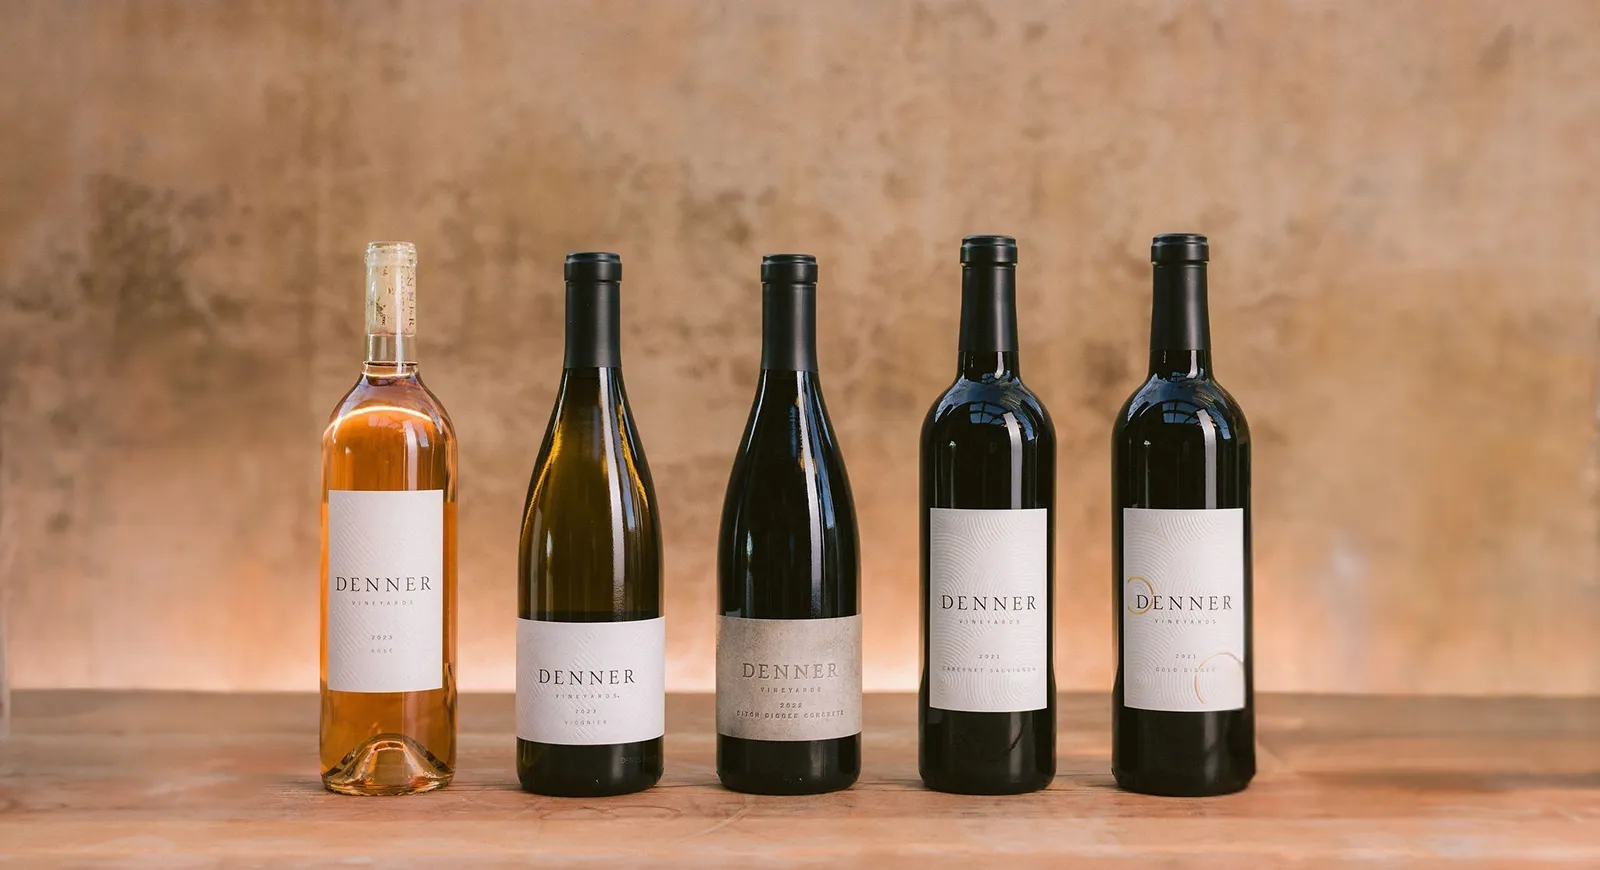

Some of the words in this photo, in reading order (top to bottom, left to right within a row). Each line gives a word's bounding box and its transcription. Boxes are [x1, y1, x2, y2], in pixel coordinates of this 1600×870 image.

[335, 576, 432, 592] DENNER
[940, 594, 1037, 611] DENNER
[1136, 594, 1233, 611] DENNER
[538, 668, 635, 686] DENNER
[742, 662, 839, 680] DENNER
[989, 666, 1037, 674] SAUVIGNON
[760, 686, 822, 694] VINEYARDS
[736, 710, 760, 718] DITCH
[803, 709, 845, 719] CONCRETE
